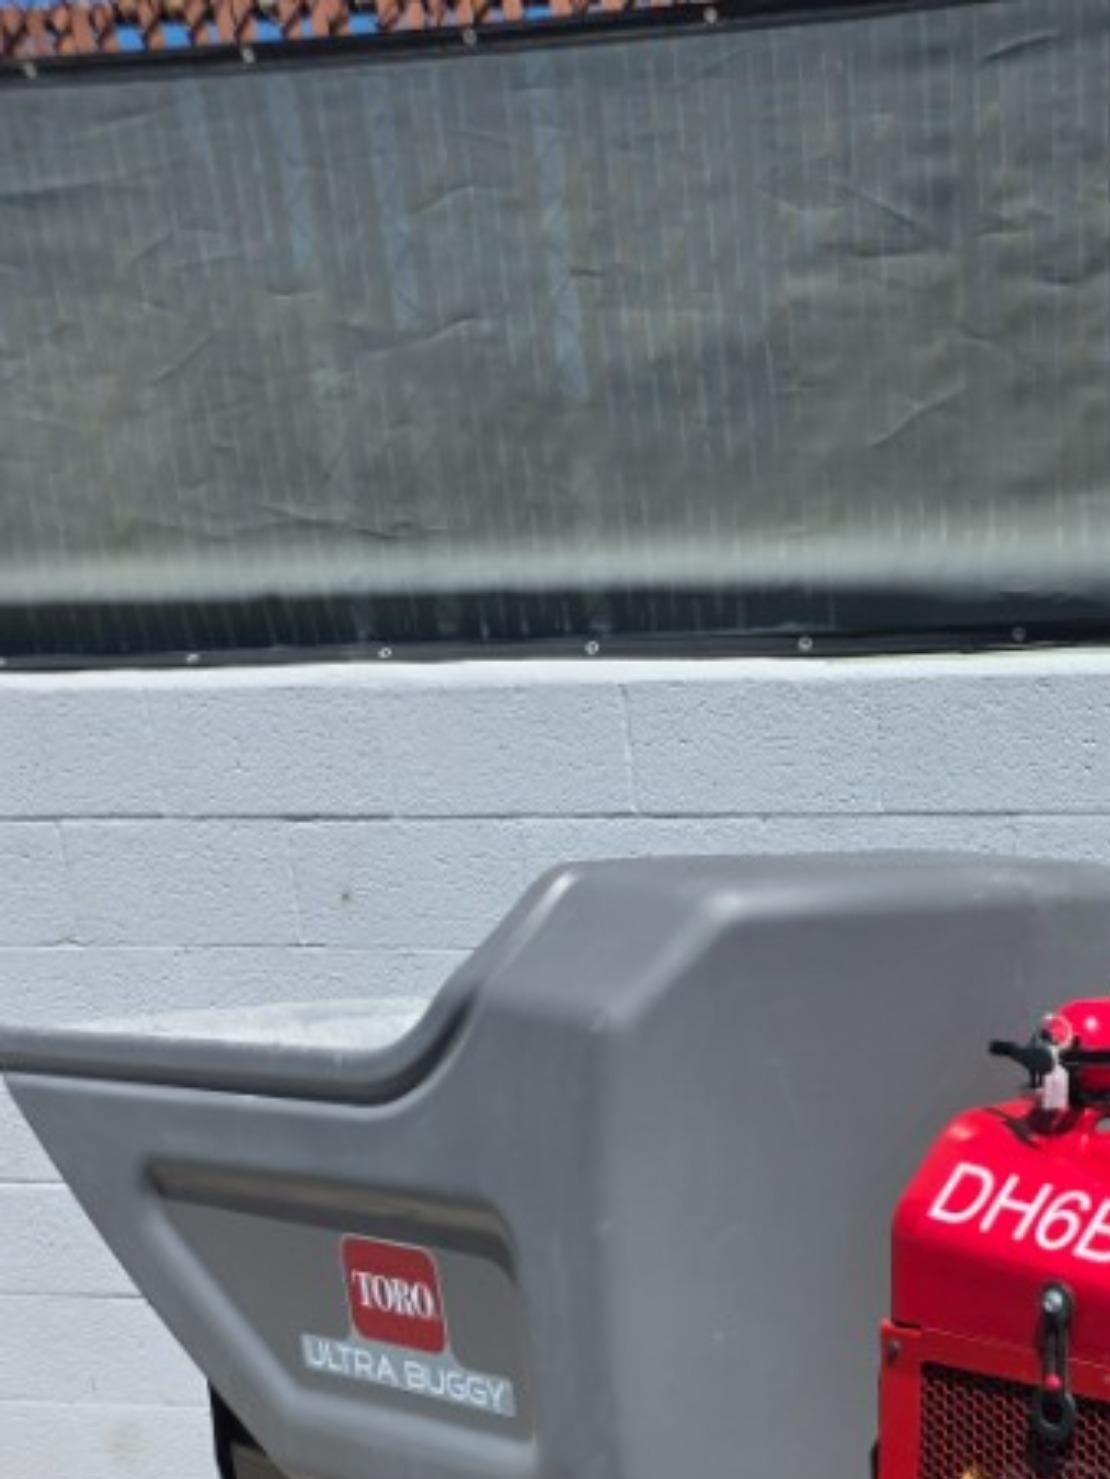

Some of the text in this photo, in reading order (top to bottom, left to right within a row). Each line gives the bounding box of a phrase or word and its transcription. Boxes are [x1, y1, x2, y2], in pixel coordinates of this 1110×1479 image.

[352, 1271, 435, 1318] TORO
[307, 1339, 506, 1412] ULTRA BUGGY
